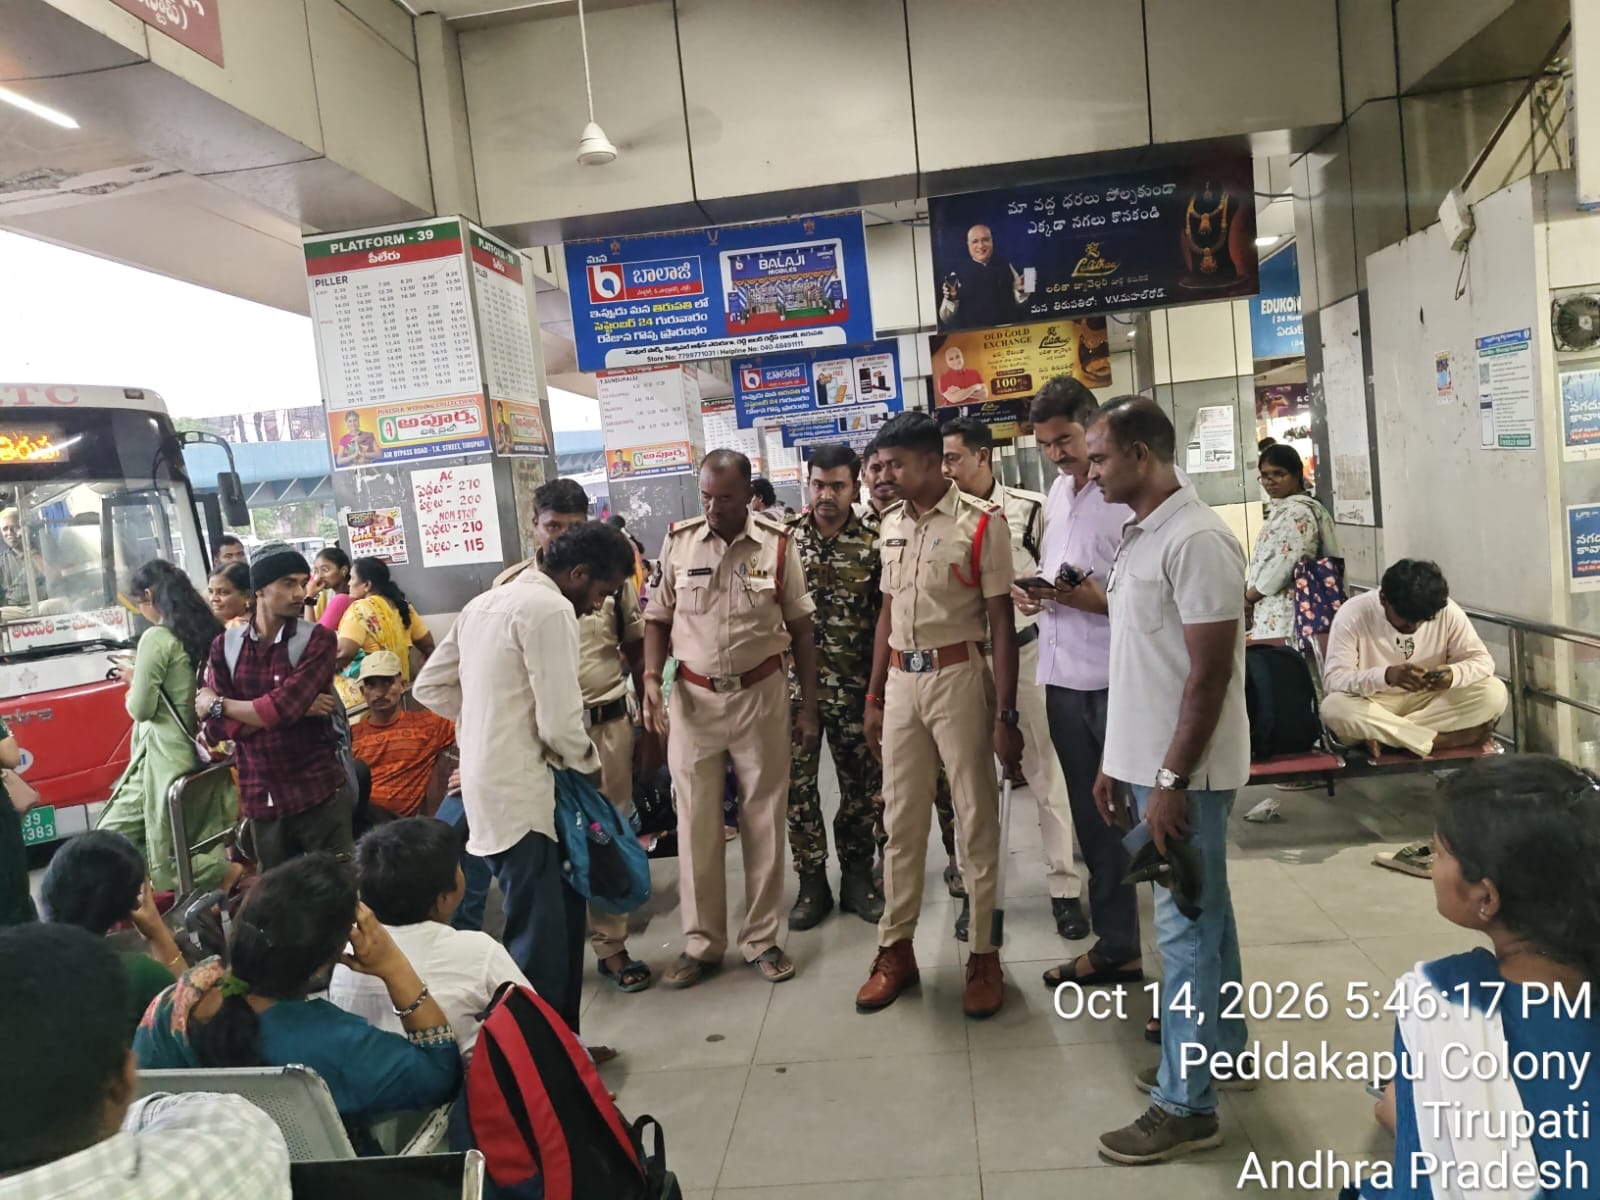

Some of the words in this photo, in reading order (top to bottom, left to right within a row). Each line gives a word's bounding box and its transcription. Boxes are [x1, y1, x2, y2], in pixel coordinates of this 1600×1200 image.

[1007, 201, 1028, 216] మా
[1034, 198, 1056, 216] వద్ద
[1062, 193, 1101, 210] ధరలు
[1027, 220, 1066, 238] ఎక్కడా
[1072, 214, 1106, 229] నగలు
[1111, 206, 1160, 224] కొనకండి
[330, 233, 405, 254] PLATFORM
[416, 229, 435, 242] 39
[586, 254, 607, 264] మన
[759, 255, 805, 270] BALAJI
[768, 267, 797, 275] MOBILES
[314, 275, 349, 288] PILLER
[629, 304, 651, 315] మన
[653, 301, 692, 313] తిరుపతి
[1031, 303, 1048, 314] మన
[638, 318, 654, 327] 24
[655, 313, 708, 326] గురువారం
[984, 331, 1004, 341] OLD
[1004, 328, 1030, 338] GOLD
[983, 336, 1032, 349] EXCHANGE
[647, 355, 664, 363] Store
[665, 353, 676, 361] No:
[720, 347, 747, 356] Helpline
[747, 345, 759, 353] No:
[440, 470, 454, 481] AC
[458, 478, 480, 491] 270
[459, 494, 482, 505] 200
[457, 507, 478, 520] STOP
[462, 520, 483, 533] 210
[464, 537, 485, 552] 115
[22, 823, 54, 841] 383
